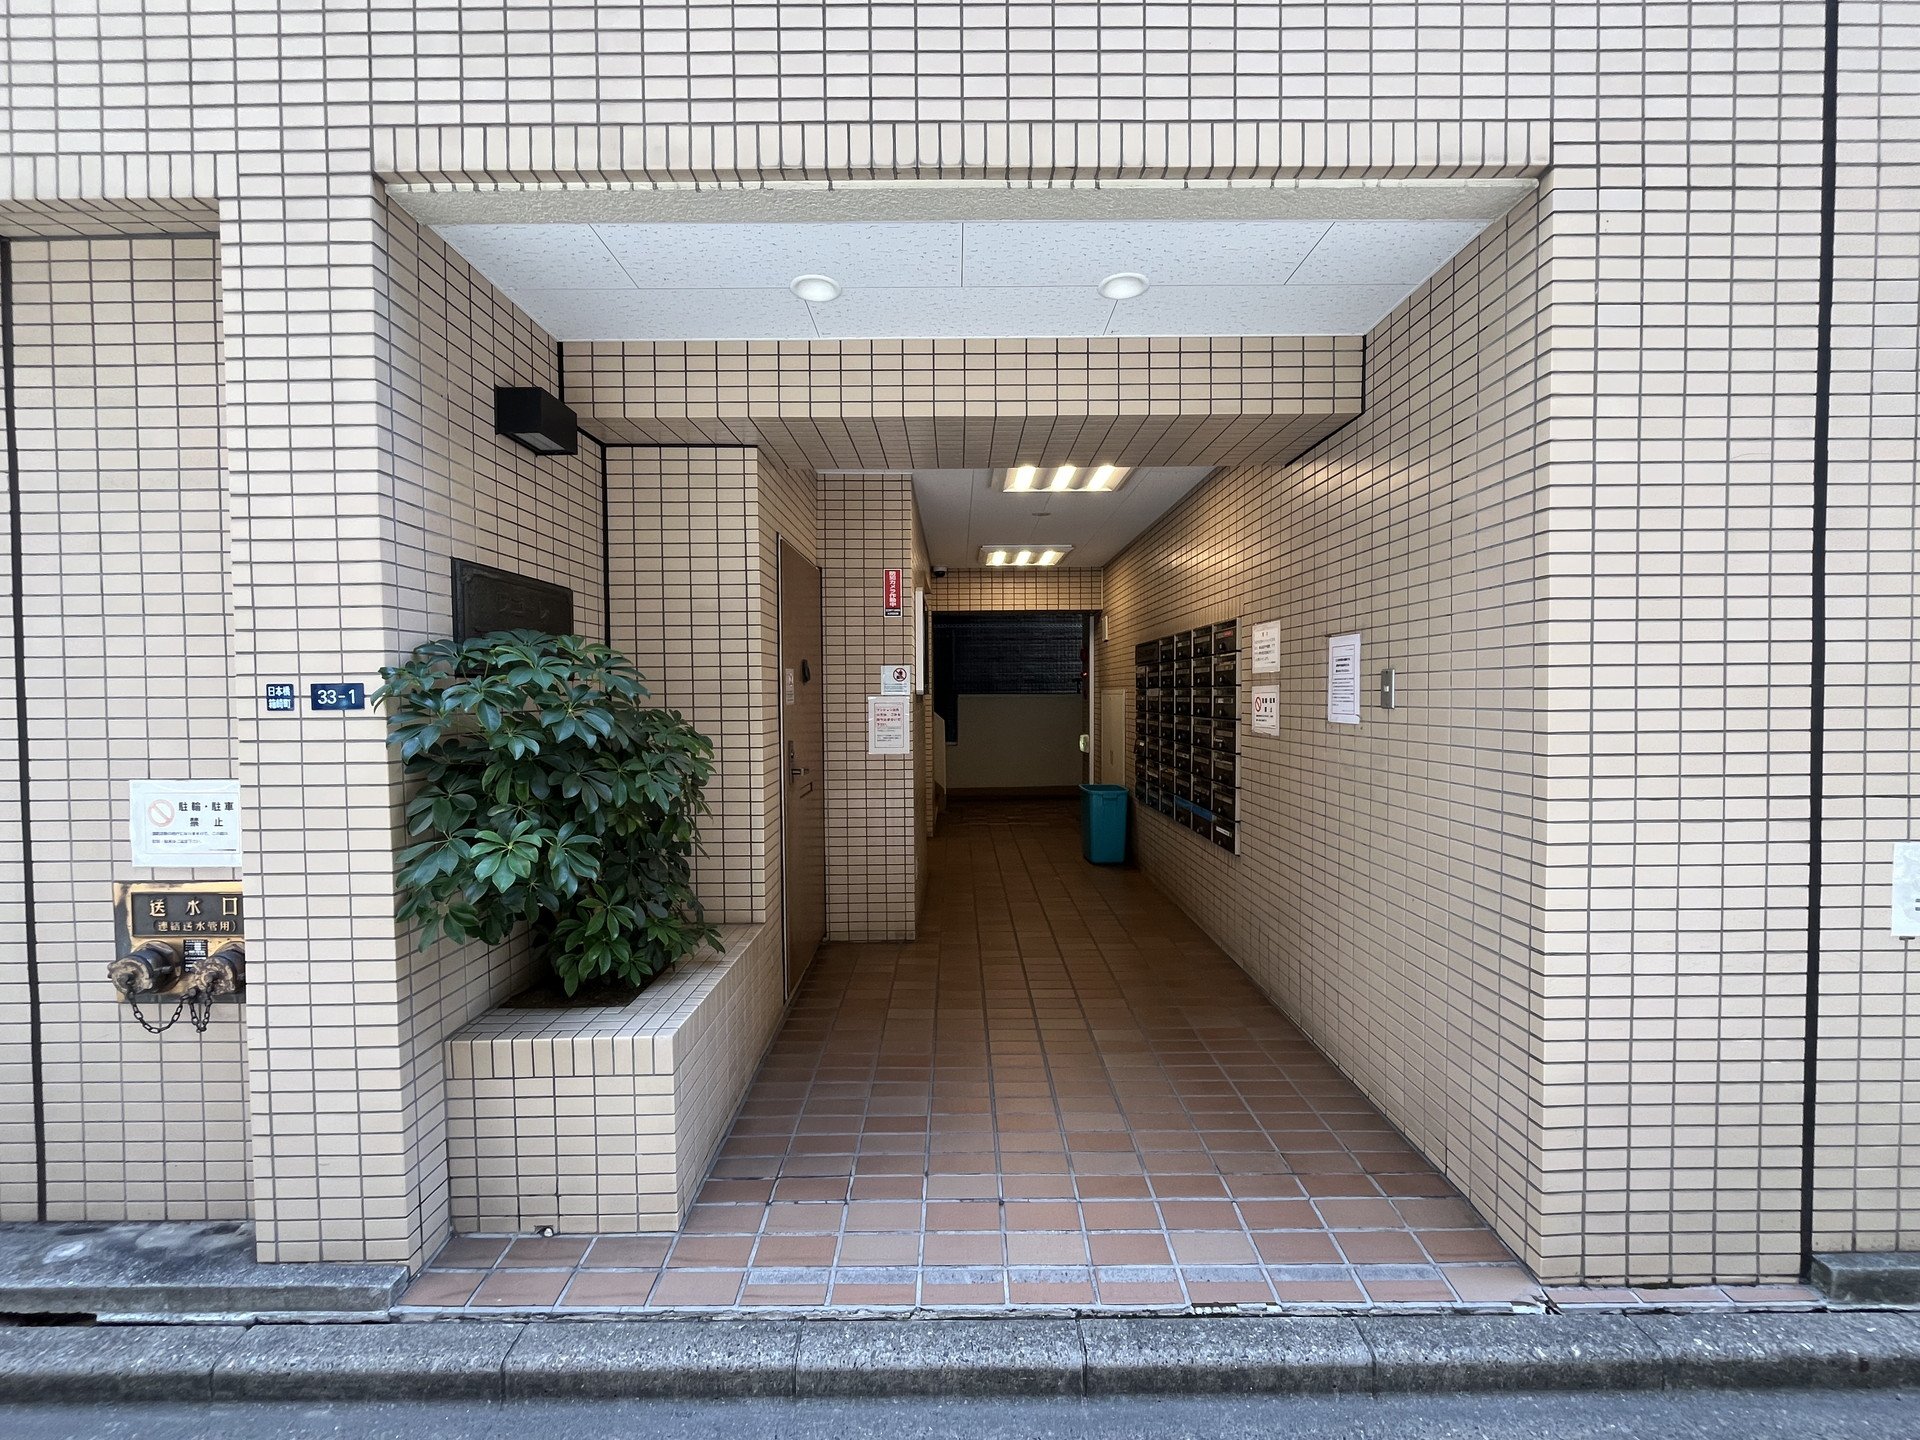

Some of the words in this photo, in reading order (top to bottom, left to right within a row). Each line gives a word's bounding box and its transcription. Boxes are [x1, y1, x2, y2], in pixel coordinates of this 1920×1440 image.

[267, 686, 291, 697] 日本橋
[317, 689, 356, 705] 33-1
[268, 698, 291, 709] 箱崎町
[178, 801, 234, 812] 駐輪・駐車
[189, 816, 224, 827] 禁止
[149, 897, 238, 916] 送水口
